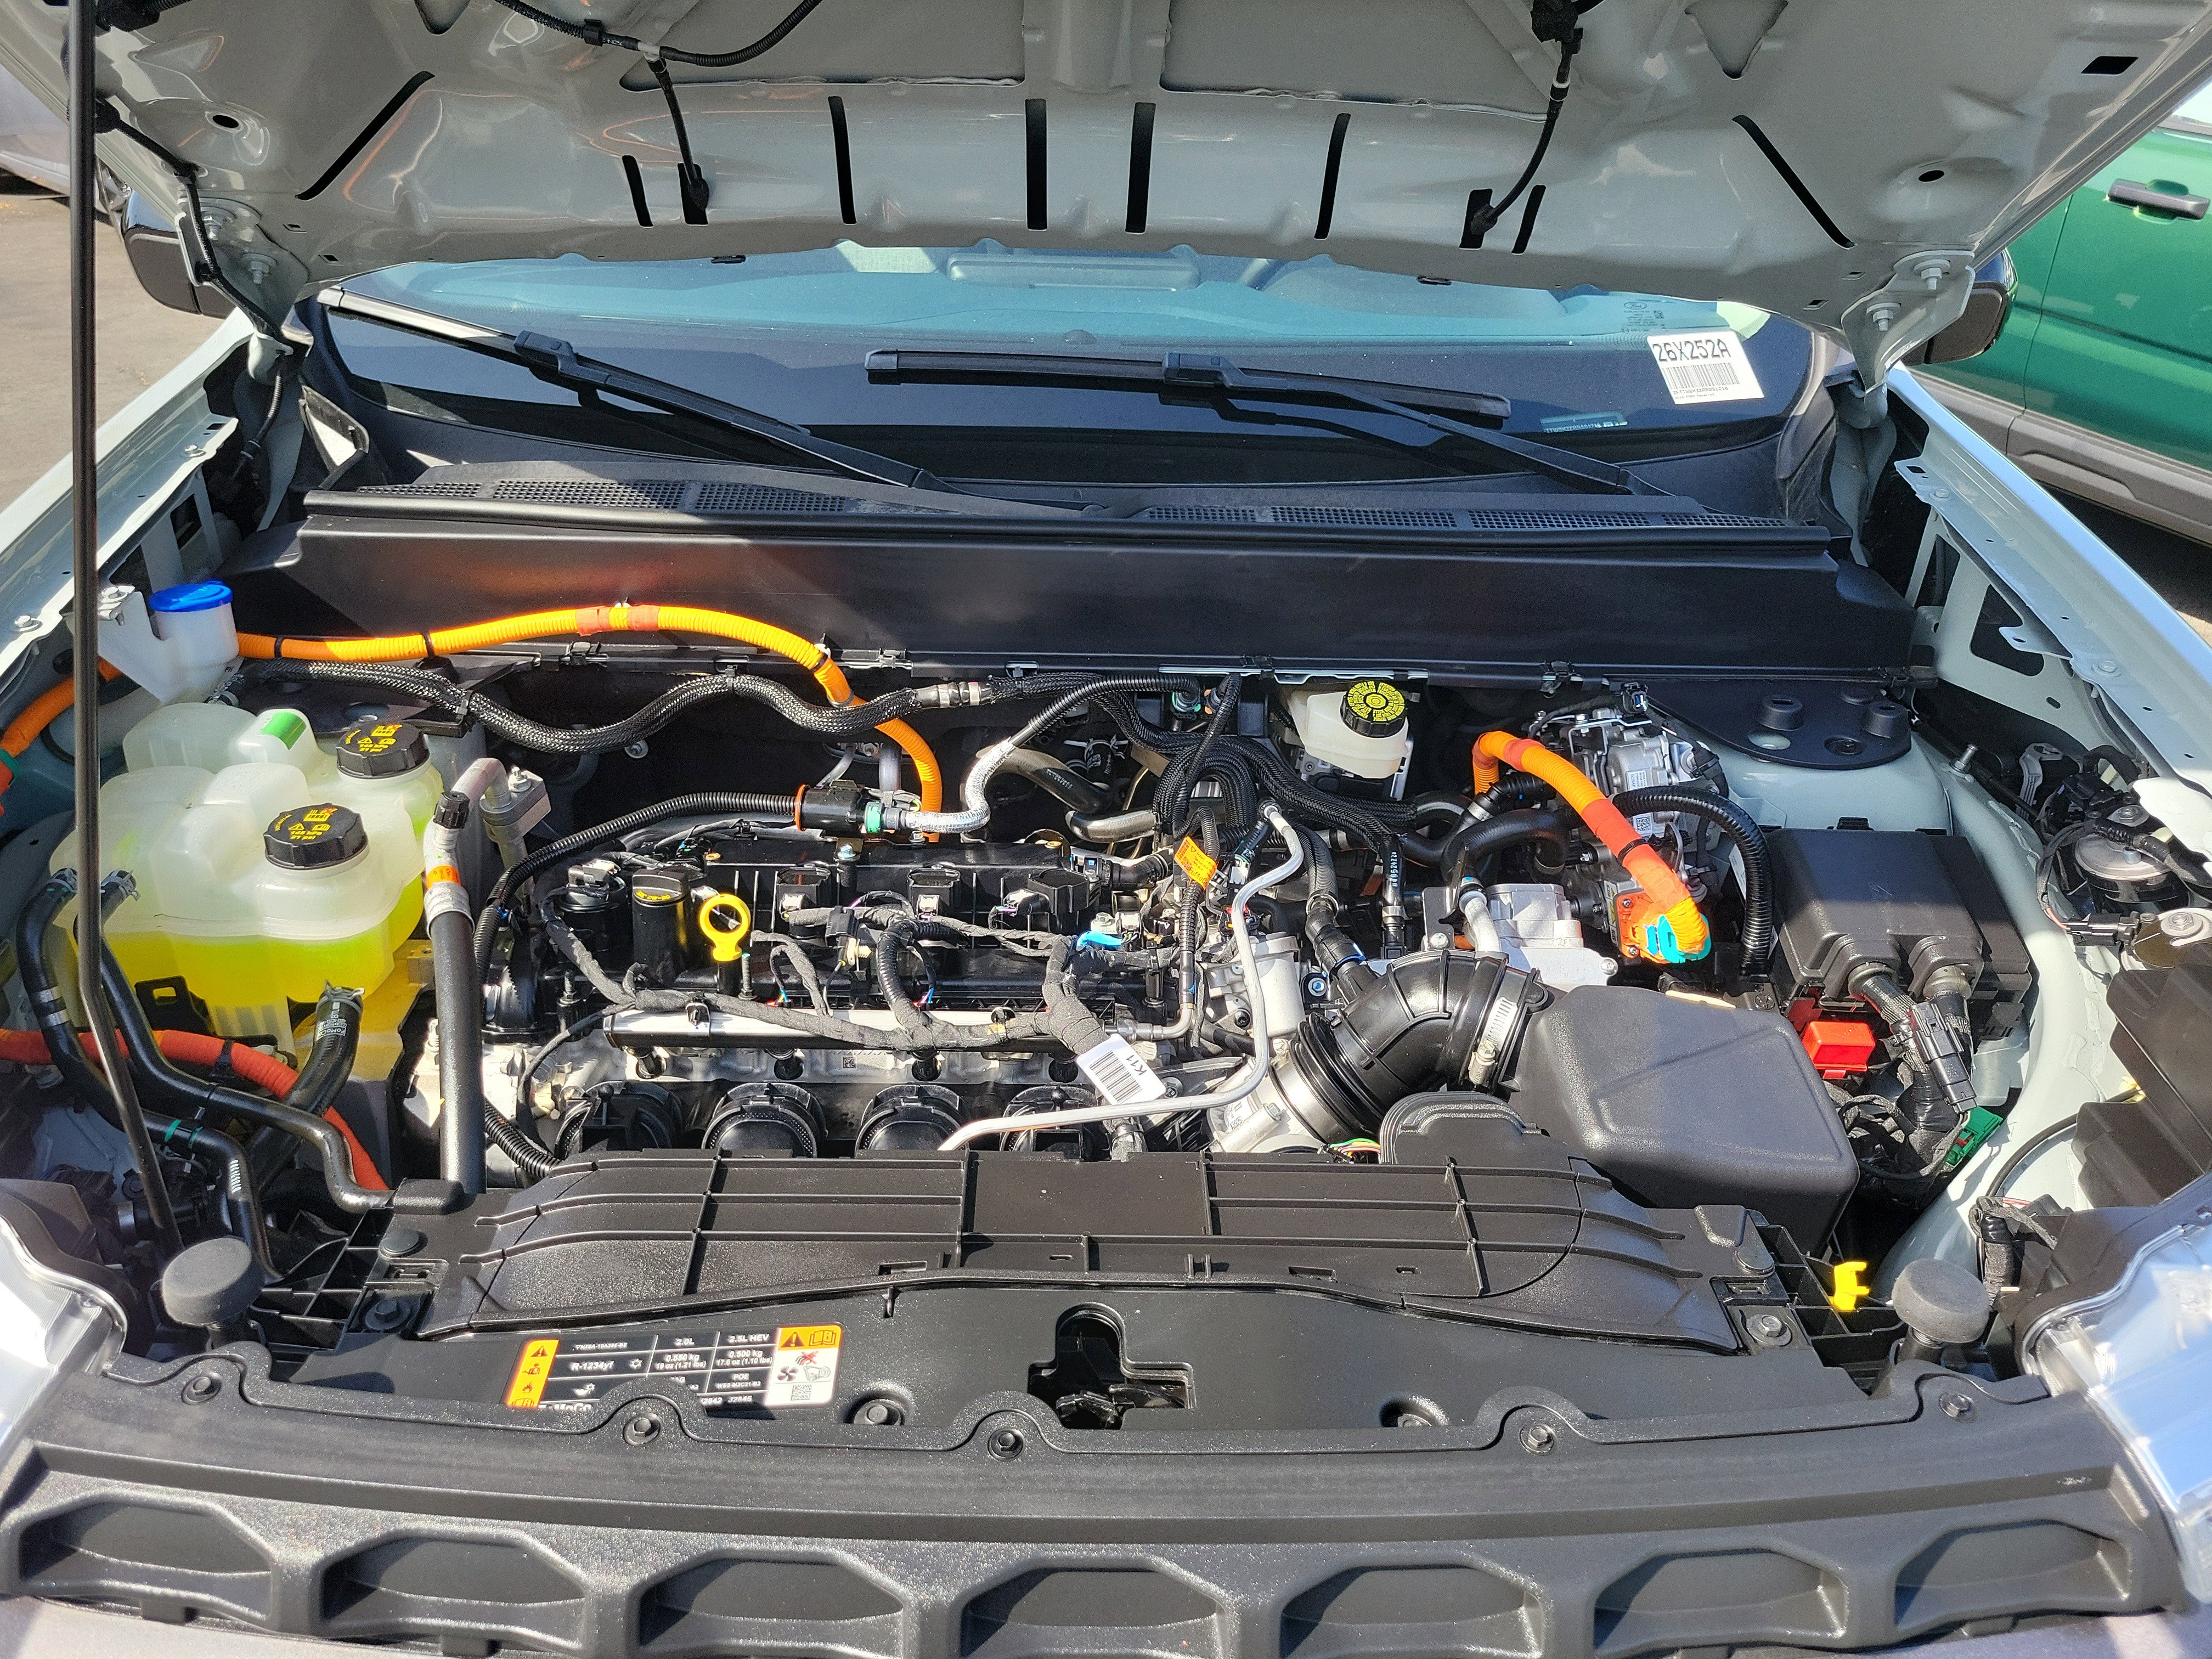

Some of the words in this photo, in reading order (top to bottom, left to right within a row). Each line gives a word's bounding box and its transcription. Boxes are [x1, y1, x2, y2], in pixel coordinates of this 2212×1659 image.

[1652, 338, 1731, 362] 26X252A
[1125, 1054, 1147, 1076] K11
[675, 1338, 695, 1346] 2.0L
[728, 1334, 748, 1343] 2.5L
[749, 1333, 770, 1342] HEV
[665, 1353, 688, 1362] 0.550
[689, 1353, 701, 1362] kg
[729, 1350, 752, 1358] 0.500
[754, 1349, 764, 1358] kg
[570, 1361, 615, 1370] R-1234yf
[675, 1361, 691, 1370] (1.21
[693, 1360, 707, 1369] lbs)
[716, 1358, 731, 1367] 17.6
[742, 1357, 758, 1366] (1.10
[759, 1356, 773, 1364] lbs)
[731, 1373, 750, 1381] POE
[727, 1395, 753, 1403] J2845
